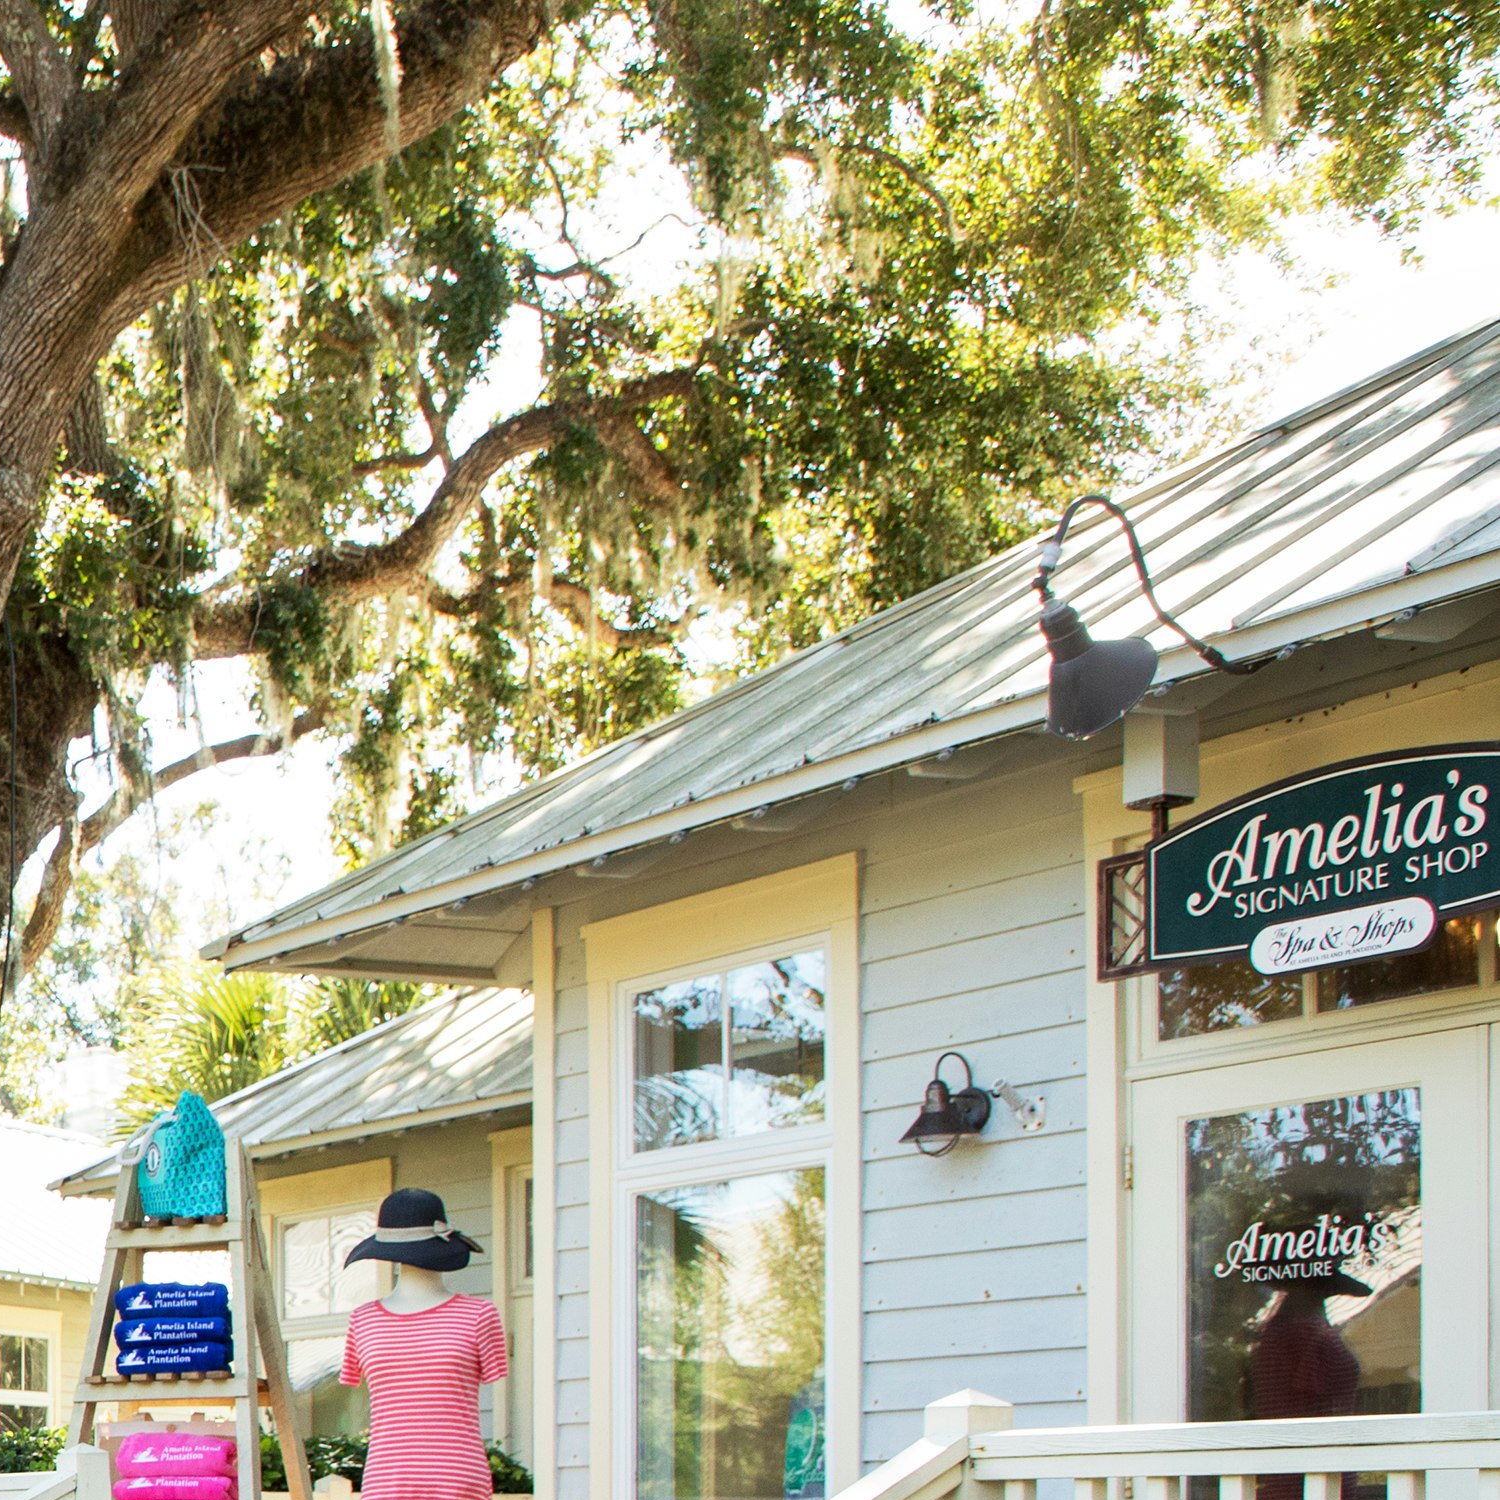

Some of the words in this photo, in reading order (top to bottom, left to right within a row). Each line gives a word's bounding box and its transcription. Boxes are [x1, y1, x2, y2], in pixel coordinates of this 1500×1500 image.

[1186, 769, 1490, 917] Amelia's
[1233, 862, 1390, 919] SIGNATURE
[1404, 841, 1489, 883] SHOP
[1268, 926, 1317, 966] Spa
[1319, 926, 1342, 950] &
[1346, 907, 1415, 947] Shops
[1320, 951, 1343, 960] ISLAND
[1214, 1211, 1389, 1278] Amelia's
[1242, 1260, 1333, 1283] SIGNATURE
[154, 1299, 198, 1308] Plantation
[154, 1322, 185, 1330] Amelia
[187, 1321, 214, 1330] Island
[153, 1331, 198, 1340] Plantation
[181, 1346, 209, 1354] Island
[147, 1355, 191, 1364] Plantation
[160, 1453, 204, 1461] Plantation
[155, 1478, 199, 1487] Plantation
